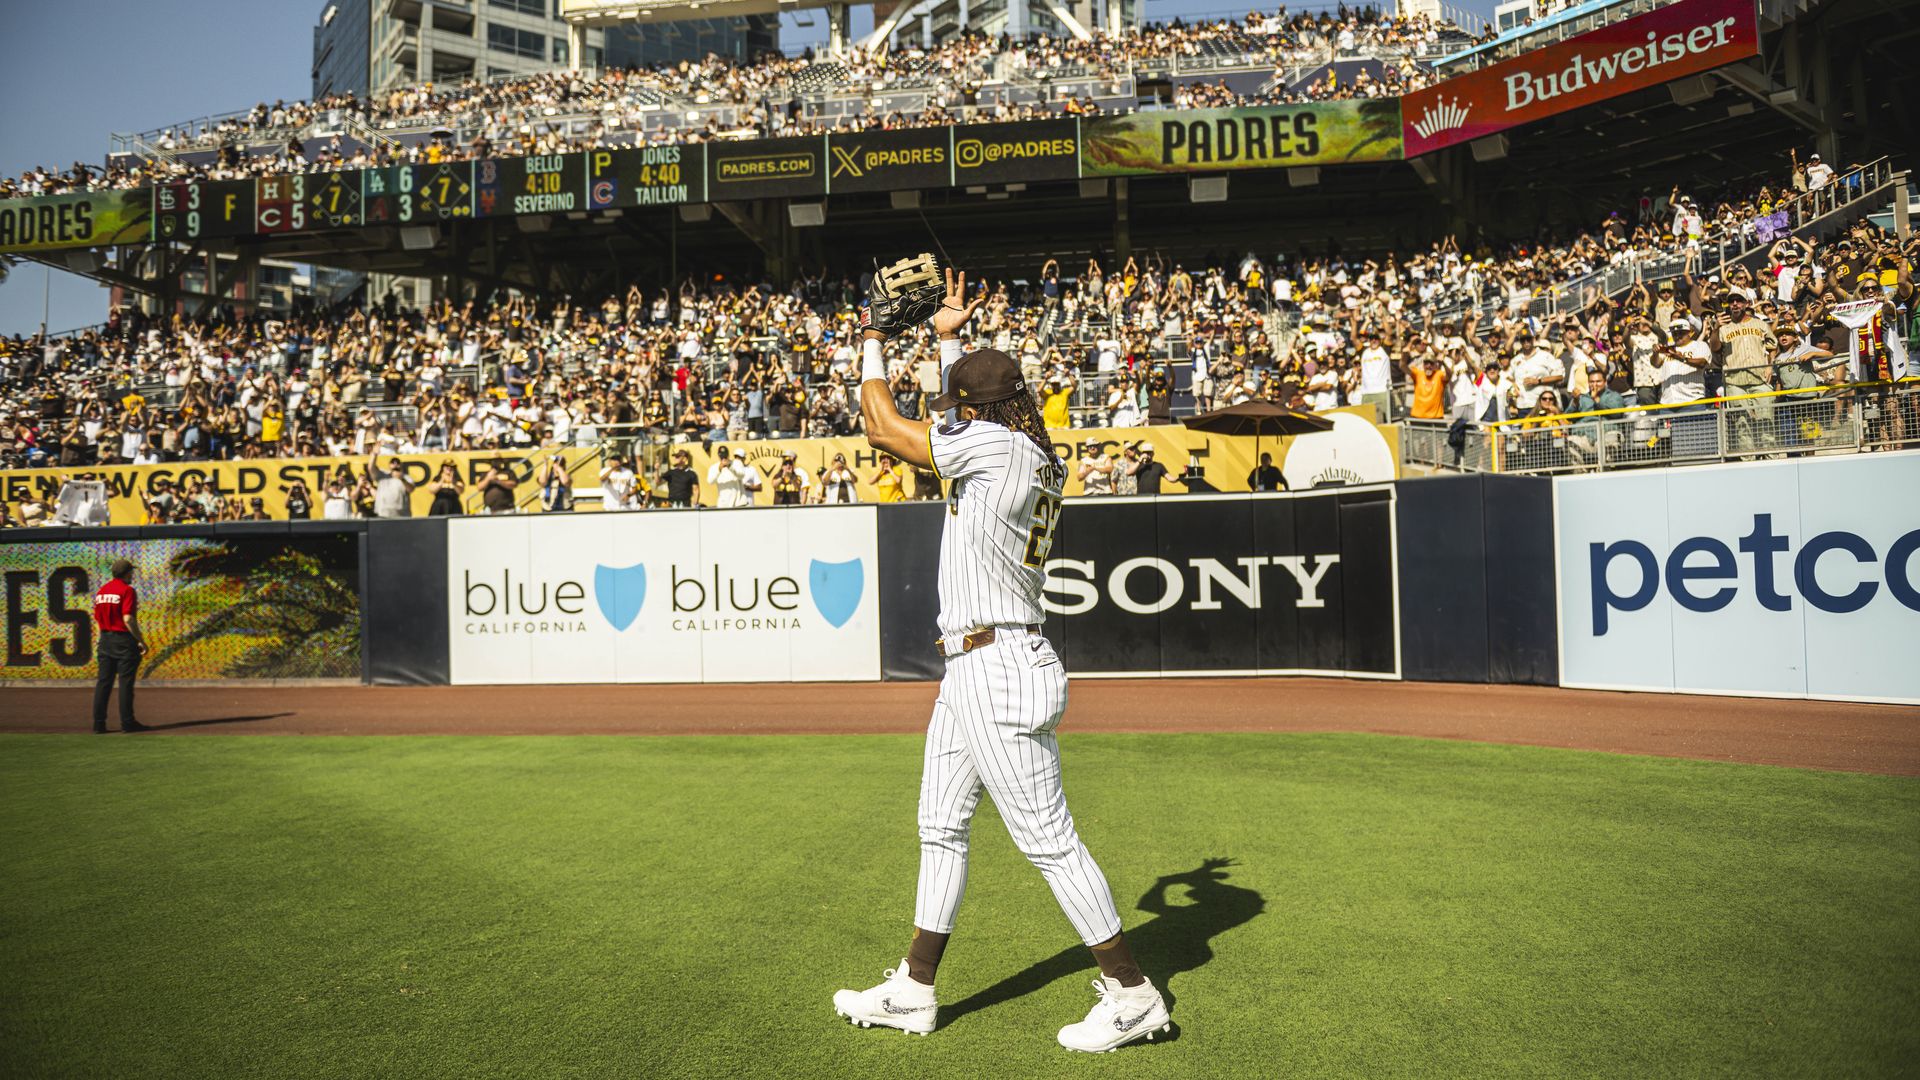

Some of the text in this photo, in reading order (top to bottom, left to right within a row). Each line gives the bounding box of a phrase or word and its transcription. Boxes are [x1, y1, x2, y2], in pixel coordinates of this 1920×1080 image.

[1504, 17, 1735, 111] Budweiser
[985, 139, 1075, 161] @PADRES
[1162, 111, 1320, 164] PADRES
[525, 154, 564, 174] BELLO
[641, 146, 681, 166] JONES
[722, 159, 811, 176] PADRES.COM
[865, 147, 945, 170] @PADRES
[400, 165, 413, 193] 6
[525, 172, 561, 194] 4:10
[640, 163, 681, 186] 4:40
[187, 184, 200, 210] 3
[291, 175, 305, 204] 3
[328, 186, 342, 213] 7
[437, 177, 450, 205] 7
[635, 184, 688, 205] TAILLON
[224, 194, 237, 221] F
[291, 202, 305, 229] 5
[399, 194, 413, 222] 3
[514, 192, 575, 214] SEVERINO
[187, 211, 200, 237] 9
[465, 563, 801, 616] blue blue
[1041, 554, 1341, 615] SONY
[465, 618, 802, 634] CALIFORNIA CALIFORNIA
